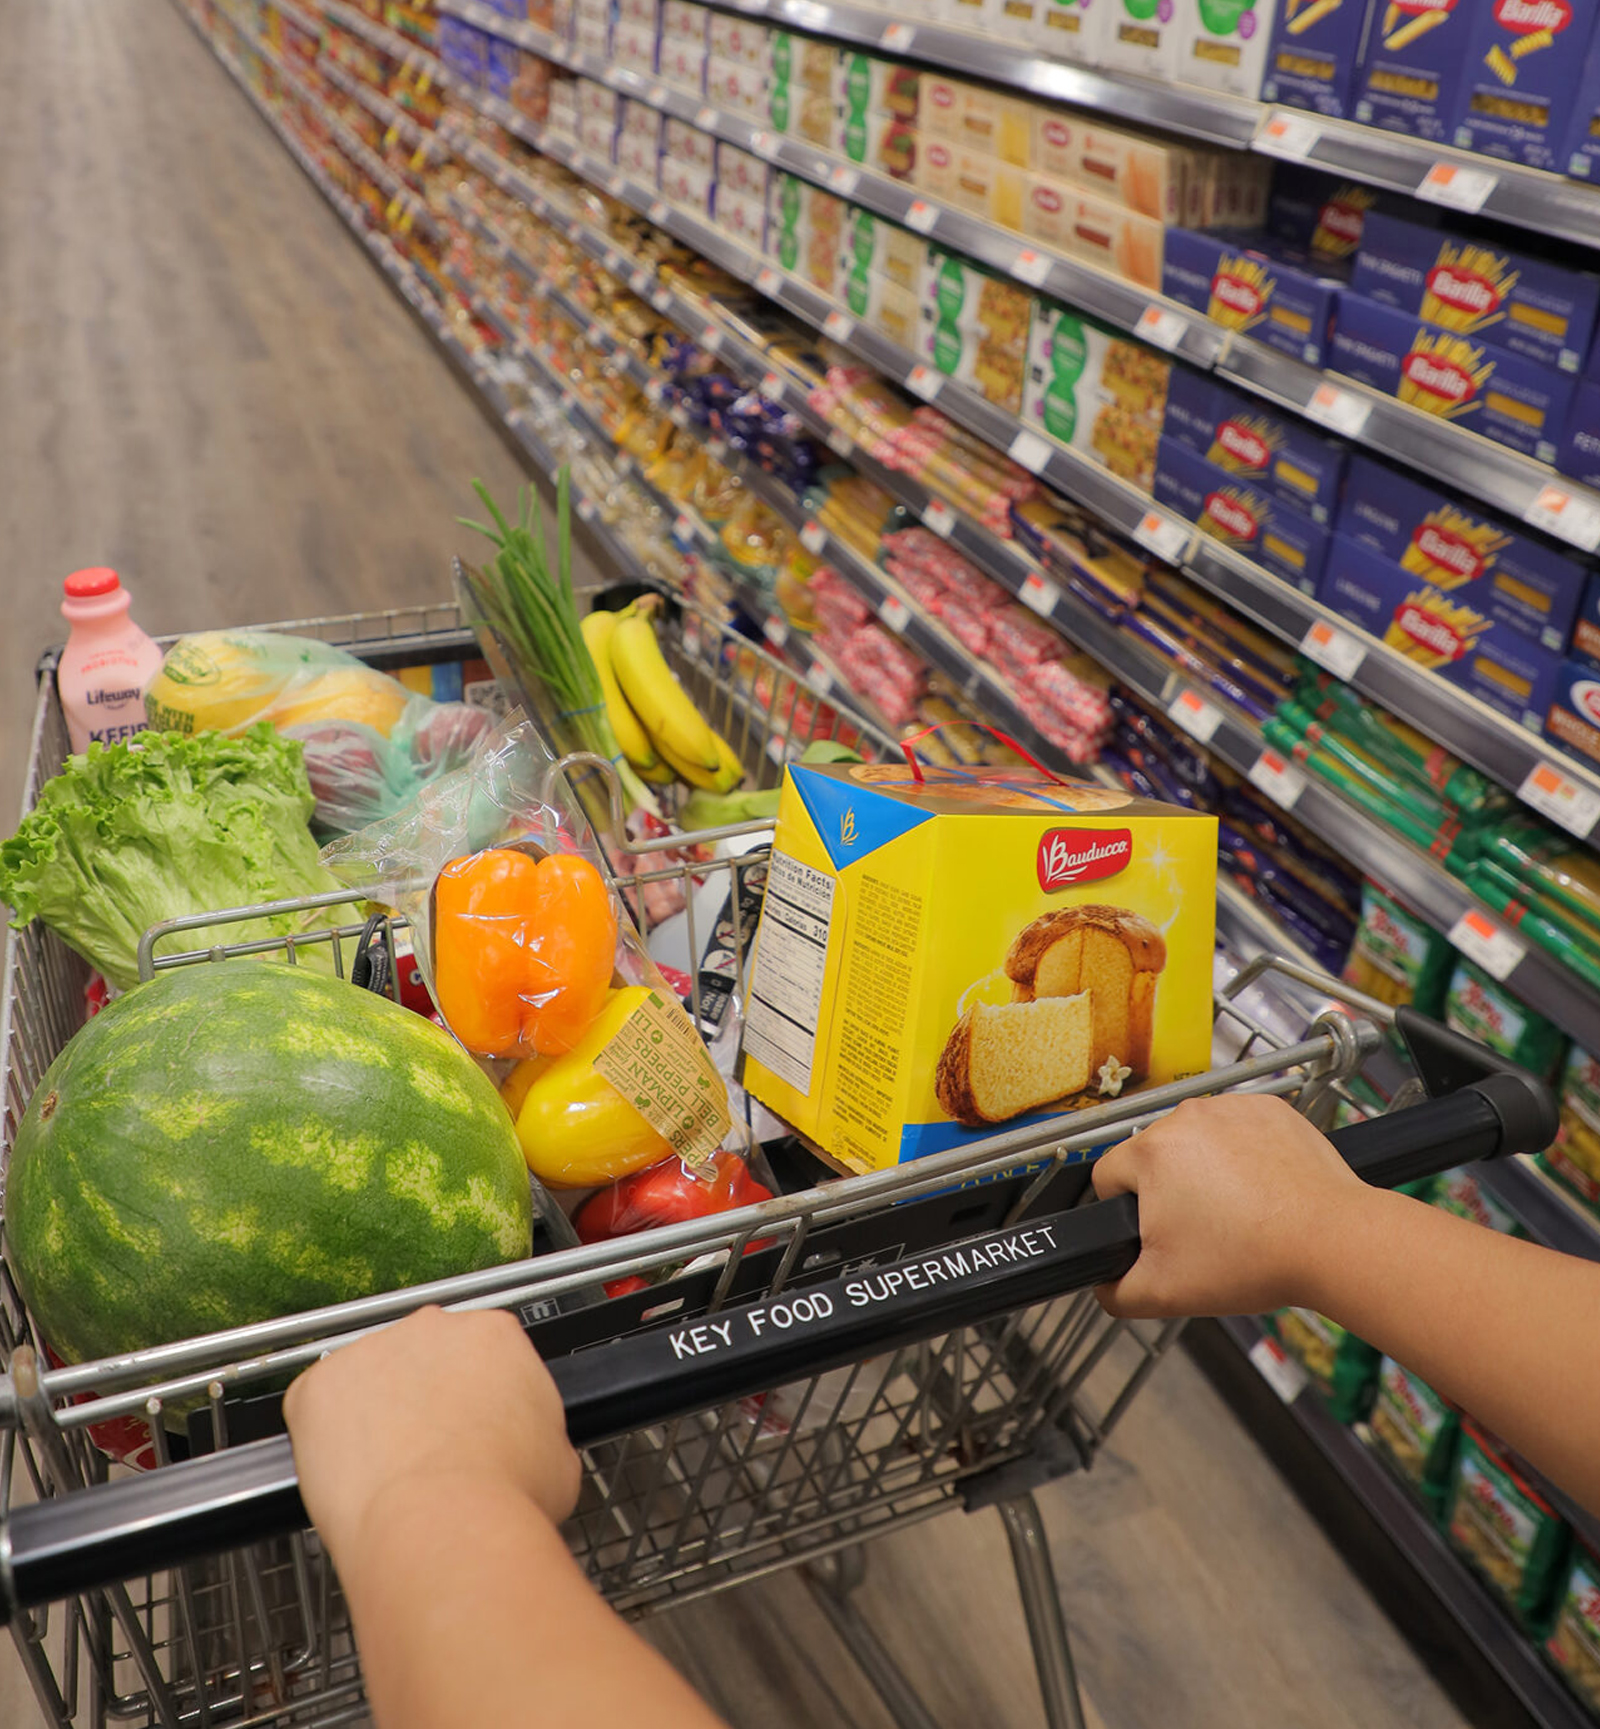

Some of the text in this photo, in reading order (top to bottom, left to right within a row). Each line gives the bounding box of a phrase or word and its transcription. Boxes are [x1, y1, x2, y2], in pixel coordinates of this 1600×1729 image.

[1431, 270, 1494, 308] Barilla
[1408, 357, 1469, 397] Barilla
[1417, 529, 1482, 576] Barilla
[1400, 609, 1464, 656] Barilla
[86, 688, 141, 705] Lifeway
[1042, 834, 1128, 884] Bauducco
[628, 1061, 684, 1118] LIPMAN
[634, 1038, 689, 1096] PEPPERS
[688, 1094, 719, 1127] BELL
[668, 1226, 1058, 1360] KEY FOOD SUPERMARKET
